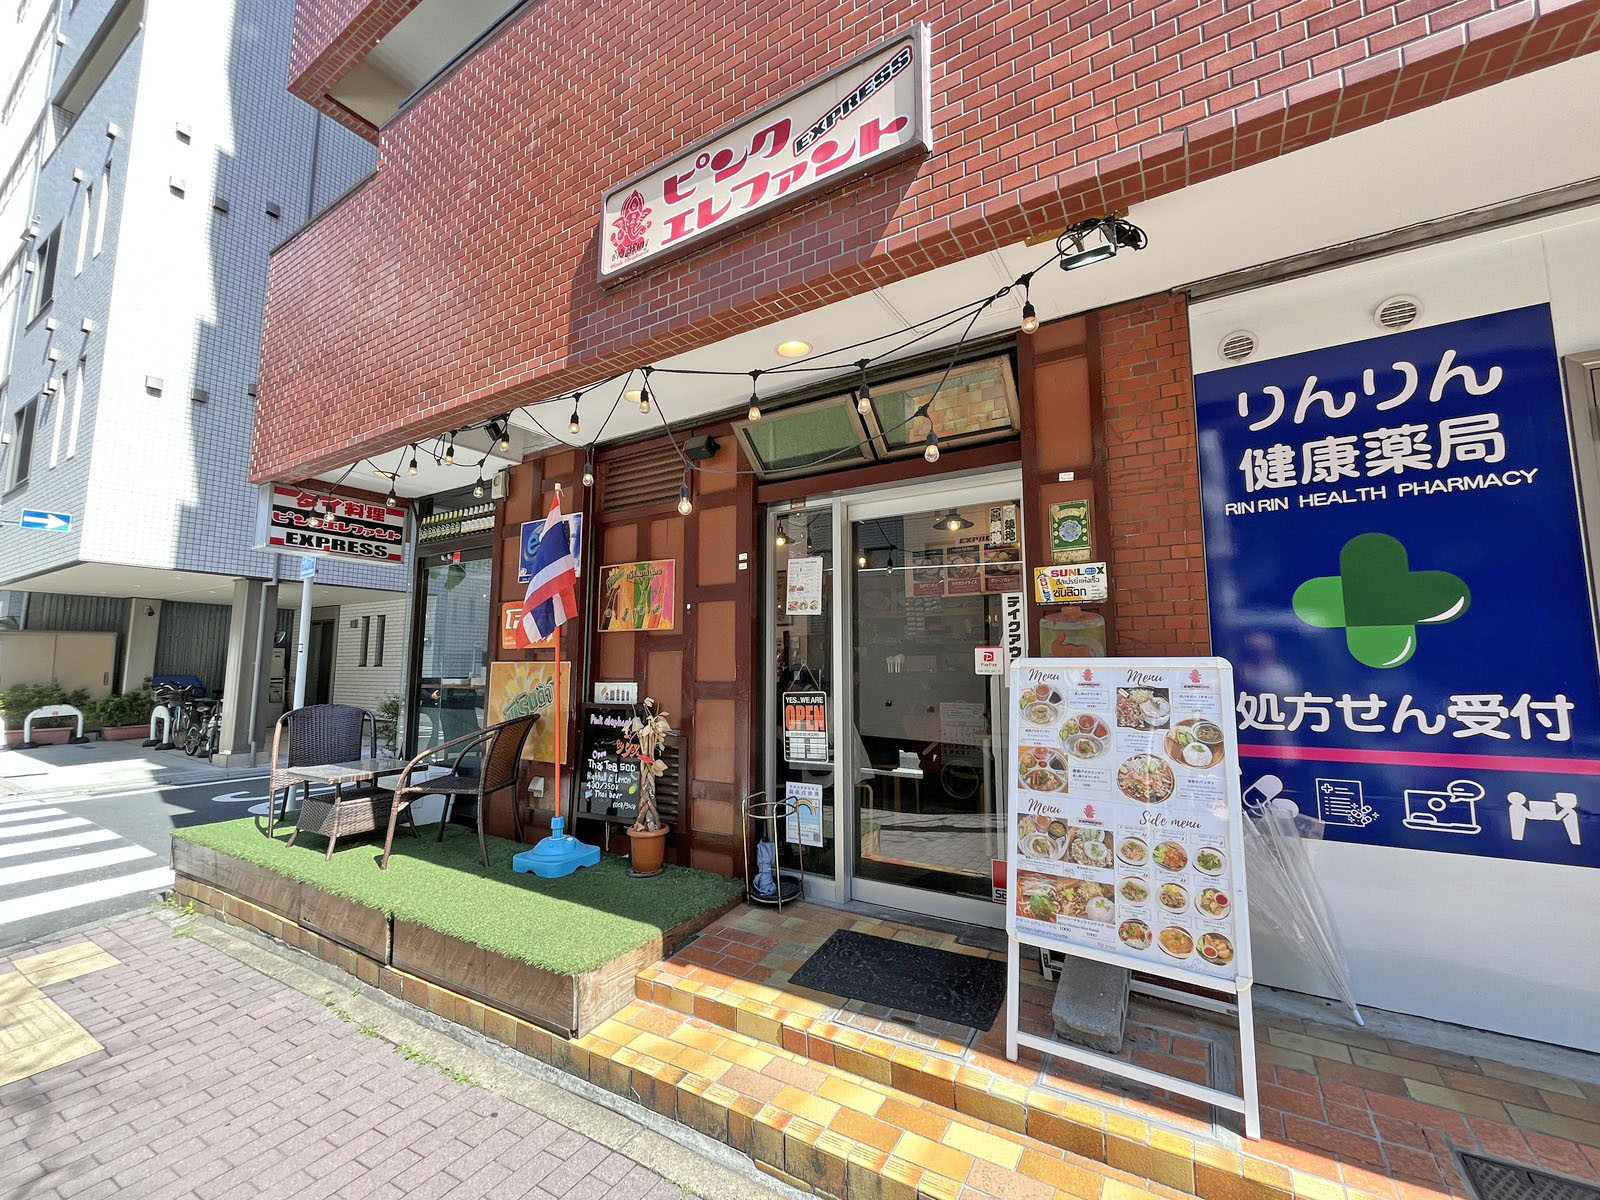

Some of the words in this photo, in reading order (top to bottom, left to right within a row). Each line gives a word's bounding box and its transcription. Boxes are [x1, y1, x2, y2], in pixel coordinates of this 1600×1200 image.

[797, 48, 910, 153] EXPRESS
[663, 118, 792, 206] ピンク
[661, 117, 910, 246] エレファント
[1237, 349, 1503, 431] りんりん
[1239, 413, 1506, 493] 健康薬局
[1299, 486, 1387, 508] HEALTH
[1398, 468, 1538, 498] PHARMACY
[296, 492, 386, 523] タイ料理
[285, 531, 388, 558] EXPRESS
[1051, 566, 1105, 578] SUNLOX
[1007, 597, 1022, 664] テイクアウ
[1029, 668, 1061, 685] Menu
[1127, 669, 1164, 686] Menu
[785, 705, 825, 731] OPEN
[1236, 692, 1574, 742] 処方せん受付
[588, 759, 603, 771] Thai
[603, 760, 618, 772] Tea
[1028, 798, 1061, 816] Menu
[1139, 810, 1168, 827] Side
[1171, 818, 1202, 829] menu
